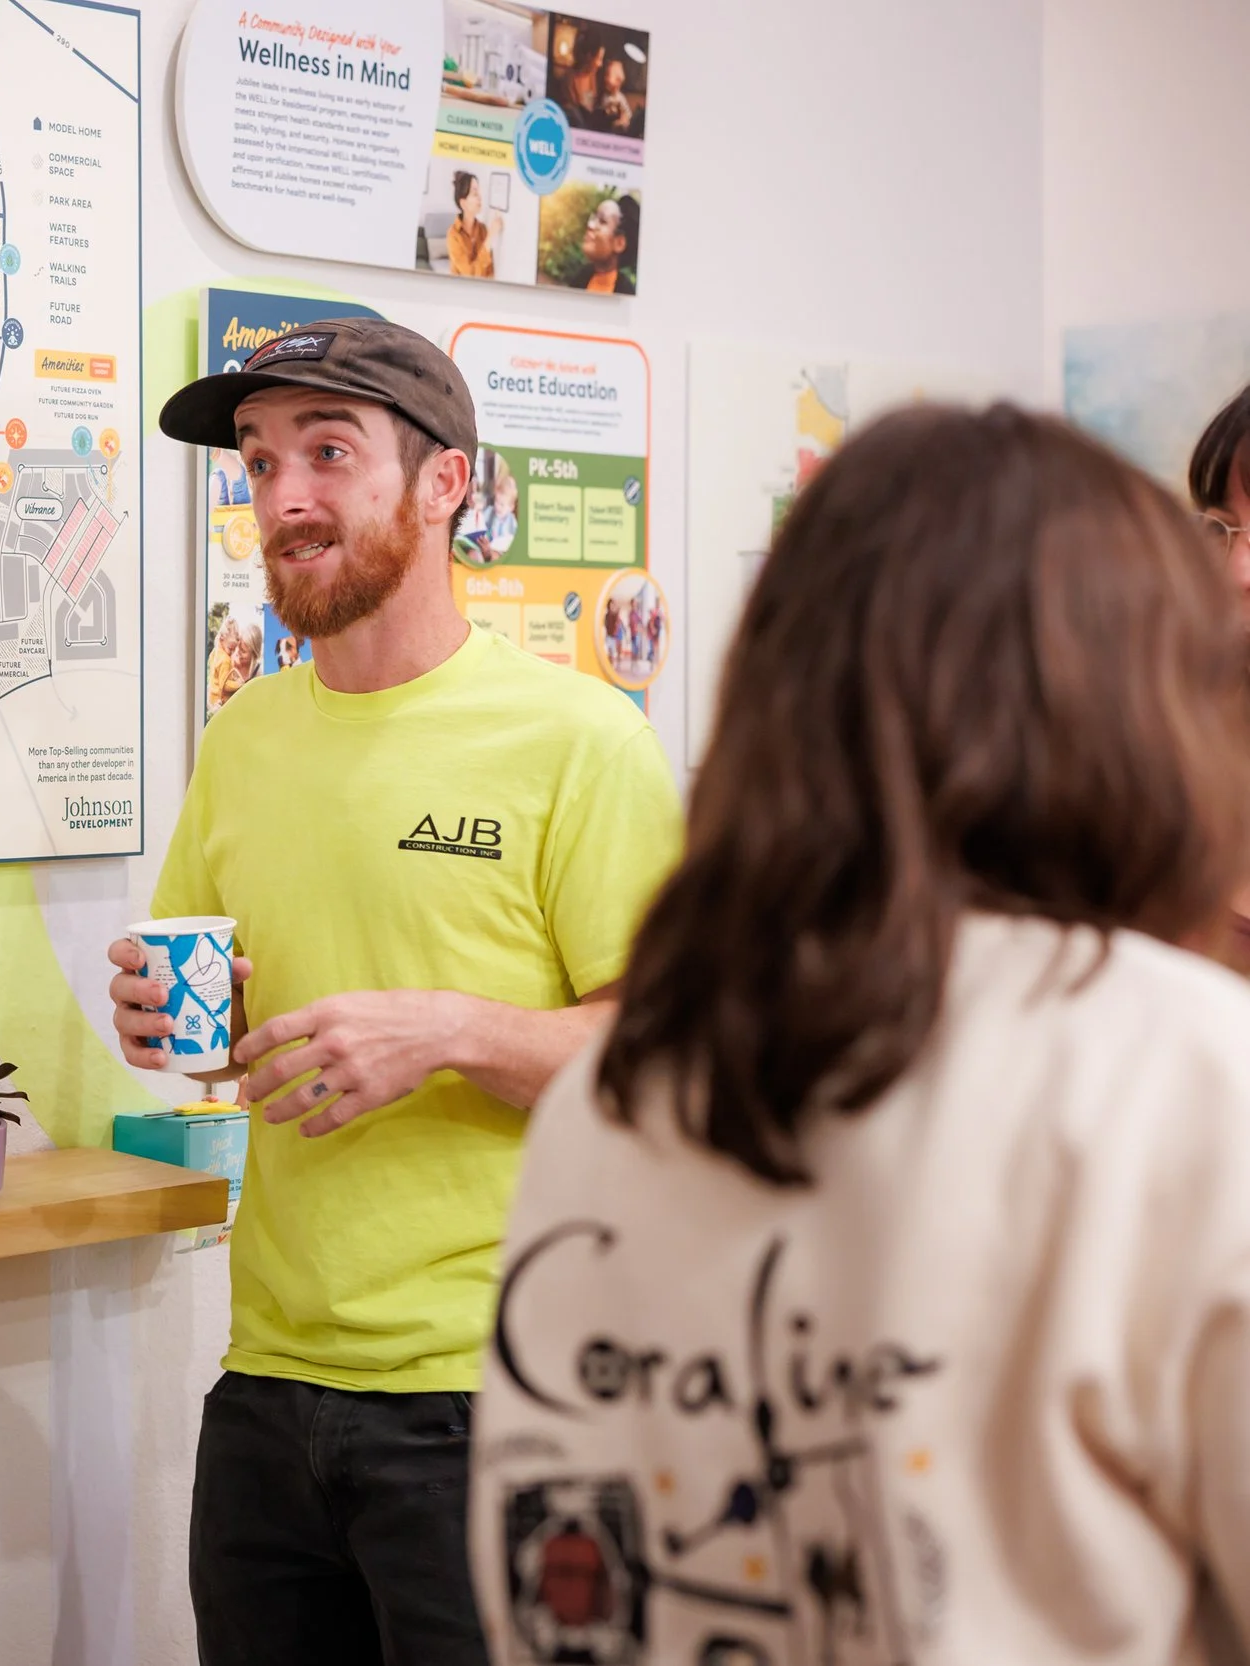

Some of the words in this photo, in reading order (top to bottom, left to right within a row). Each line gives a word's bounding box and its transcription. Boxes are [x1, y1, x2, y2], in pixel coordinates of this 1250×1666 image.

[238, 11, 246, 28] A
[56, 34, 70, 49] 290
[239, 37, 330, 76] Wellness
[338, 54, 353, 80] in
[361, 60, 410, 91] Mind
[49, 122, 76, 135] MODEL
[79, 127, 101, 138] HOME
[528, 138, 557, 157] WELL
[49, 153, 102, 168] COMMERCIAL
[49, 167, 74, 178] SPACE
[50, 196, 70, 206] PARK
[72, 199, 92, 209] AREA
[50, 223, 76, 233] WATER
[50, 236, 89, 248] FEATURES
[50, 262, 86, 274] WALKING
[50, 276, 76, 286] TRAILS
[50, 302, 80, 312] FUTURE
[50, 315, 72, 324] ROAD
[42, 357, 84, 372] Amenities
[488, 371, 534, 393] Great
[539, 375, 618, 400] Education
[529, 457, 578, 479] PK-5th
[24, 504, 55, 515] Vibrance
[29, 747, 47, 756] More
[49, 746, 88, 757] Top-Selling
[90, 746, 134, 754] communities
[39, 761, 54, 769] than
[57, 762, 69, 770] any
[71, 760, 90, 768] other
[92, 759, 125, 769] developer
[38, 774, 67, 782] America
[69, 773, 75, 781] in
[77, 773, 88, 781] the
[91, 774, 106, 783] past
[108, 772, 134, 780] decade.
[62, 796, 133, 821] Johnson
[70, 818, 133, 829] DEVELOPMENT
[409, 813, 501, 846] AJB
[406, 842, 476, 855] CONSTRUCTION
[492, 1219, 942, 1425] Coraline
